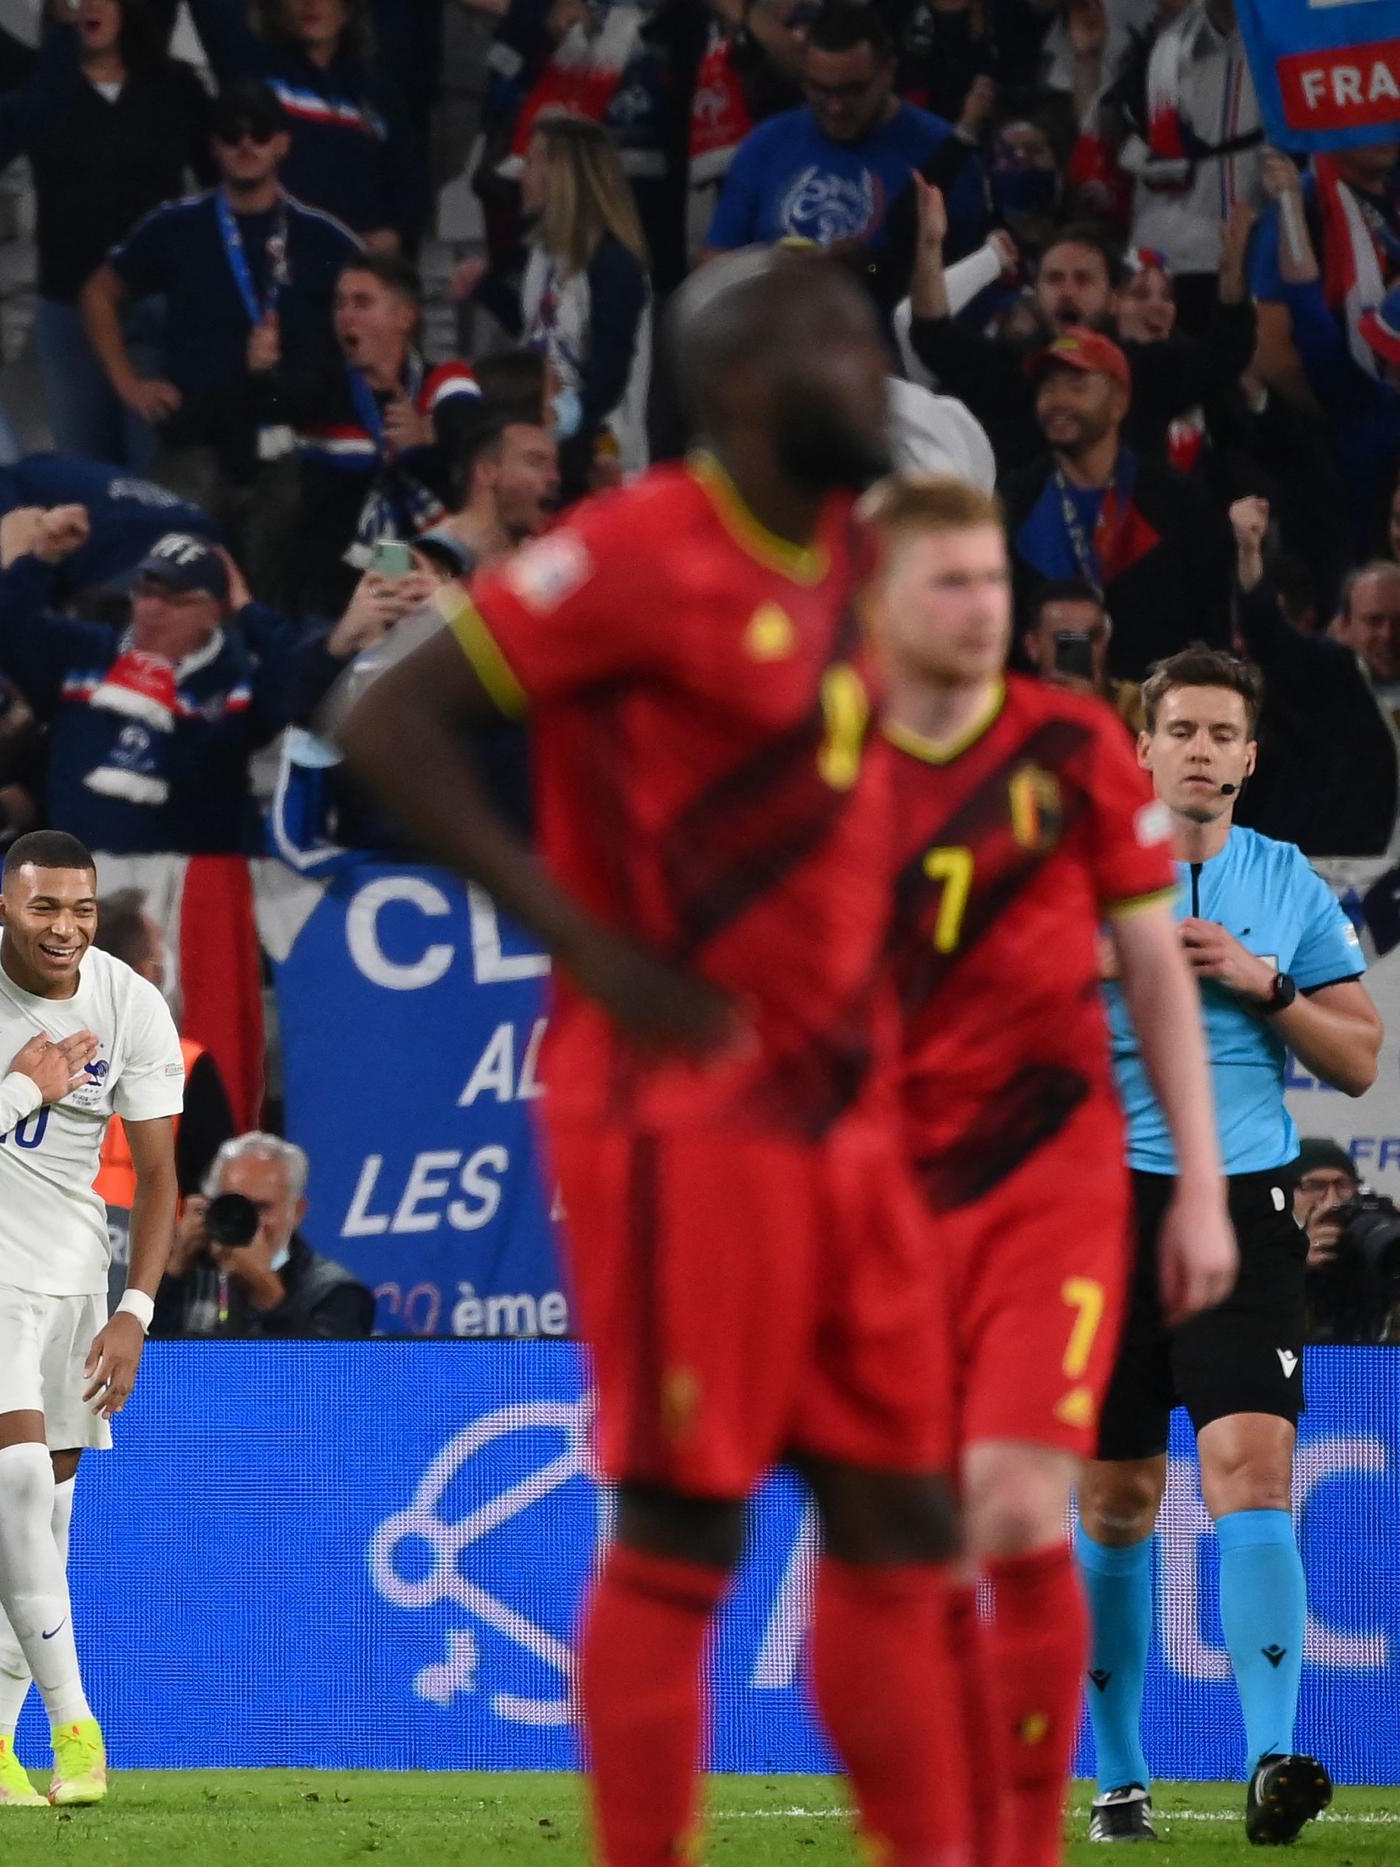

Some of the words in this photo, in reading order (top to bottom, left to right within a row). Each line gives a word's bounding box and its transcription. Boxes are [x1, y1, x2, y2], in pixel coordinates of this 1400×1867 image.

[1301, 61, 1400, 110] FRA
[923, 846, 974, 954] 7
[340, 1145, 509, 1237] LES
[1061, 1276, 1104, 1380] 7
